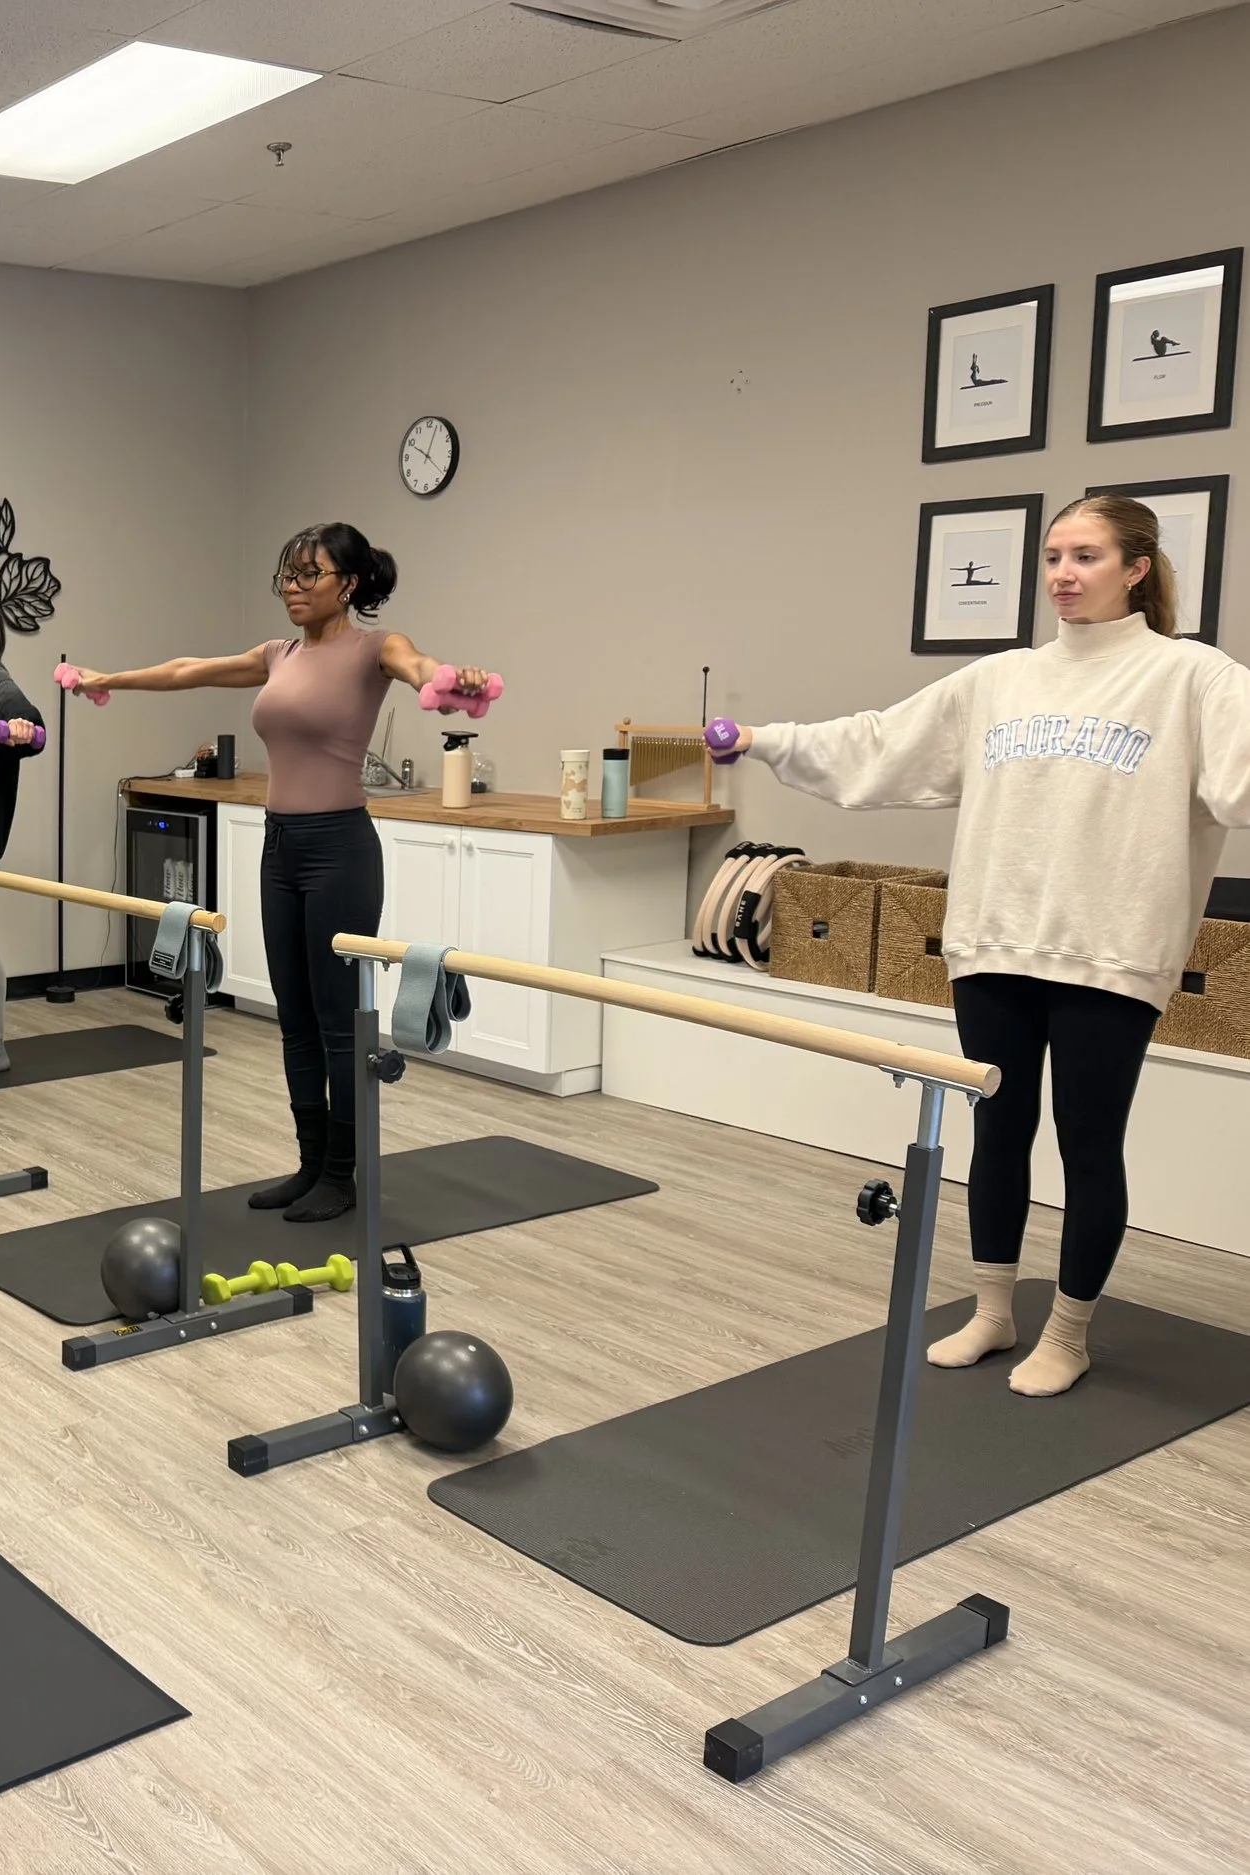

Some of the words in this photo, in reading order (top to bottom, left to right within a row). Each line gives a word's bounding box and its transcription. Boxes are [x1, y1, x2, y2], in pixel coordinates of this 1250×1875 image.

[426, 420, 433, 428] 12
[440, 424, 443, 432] 1
[416, 426, 422, 434] 11
[408, 438, 416, 447] 10
[445, 434, 451, 443] 2
[404, 454, 409, 462] 9
[406, 469, 411, 477] 8
[413, 479, 418, 488] 7
[435, 477, 440, 486] 5
[423, 483, 429, 491] 6
[714, 723, 730, 741] 3LB
[984, 715, 1151, 775] COLORADO
